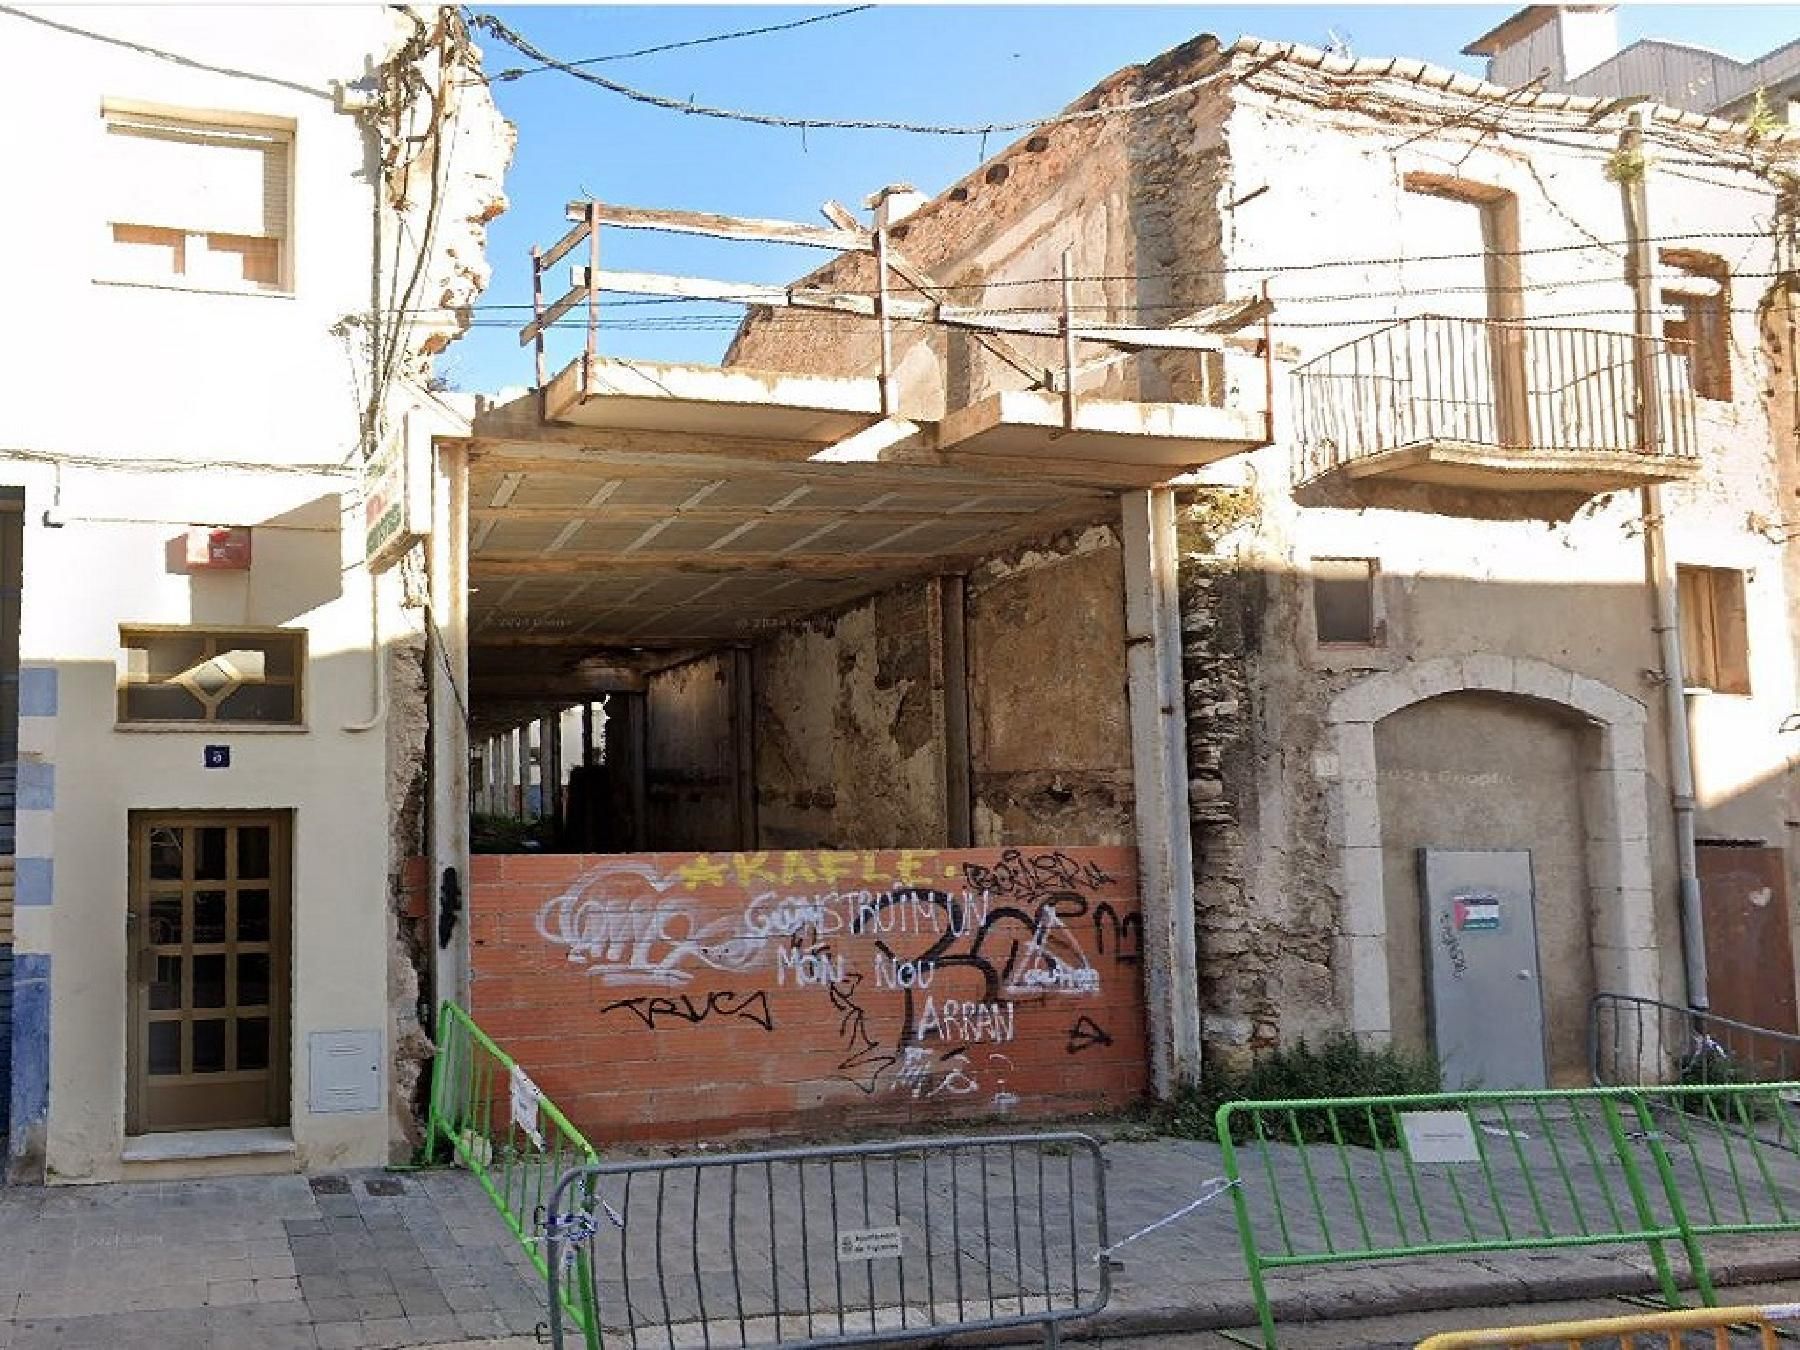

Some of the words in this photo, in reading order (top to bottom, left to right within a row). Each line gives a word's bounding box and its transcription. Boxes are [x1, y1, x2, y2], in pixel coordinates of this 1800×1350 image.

[946, 889, 989, 937] UN
[874, 950, 936, 989] NOU
[916, 995, 1014, 1043] ARRAN
